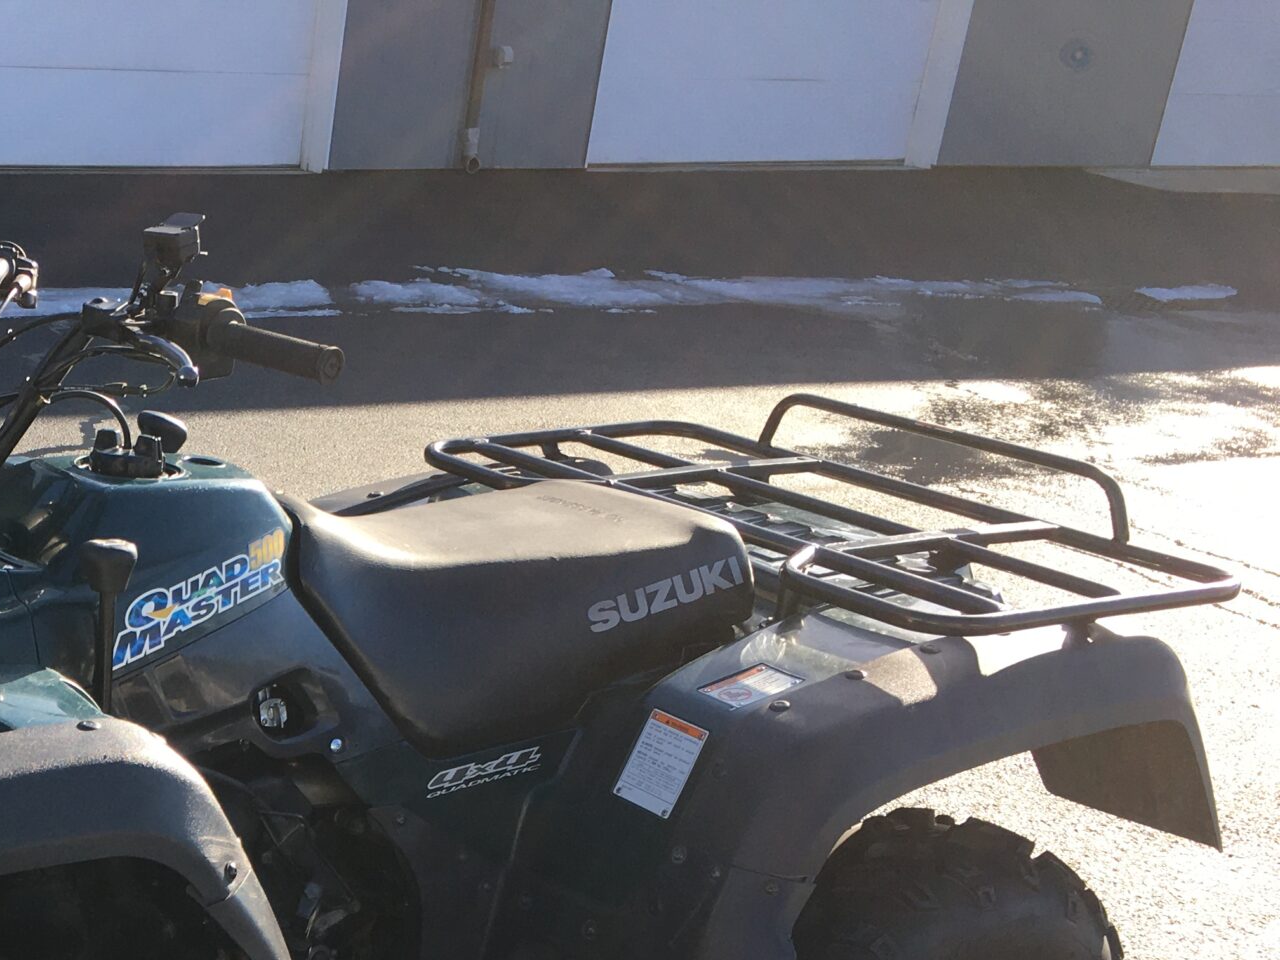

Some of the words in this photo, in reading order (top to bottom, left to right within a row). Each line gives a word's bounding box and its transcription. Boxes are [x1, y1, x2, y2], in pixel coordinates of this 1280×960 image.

[113, 560, 284, 670] MASTER
[125, 554, 251, 631] QUAD
[248, 528, 285, 571] 500
[587, 556, 744, 633] SUZUKI
[426, 764, 541, 799] QUADMATIC
